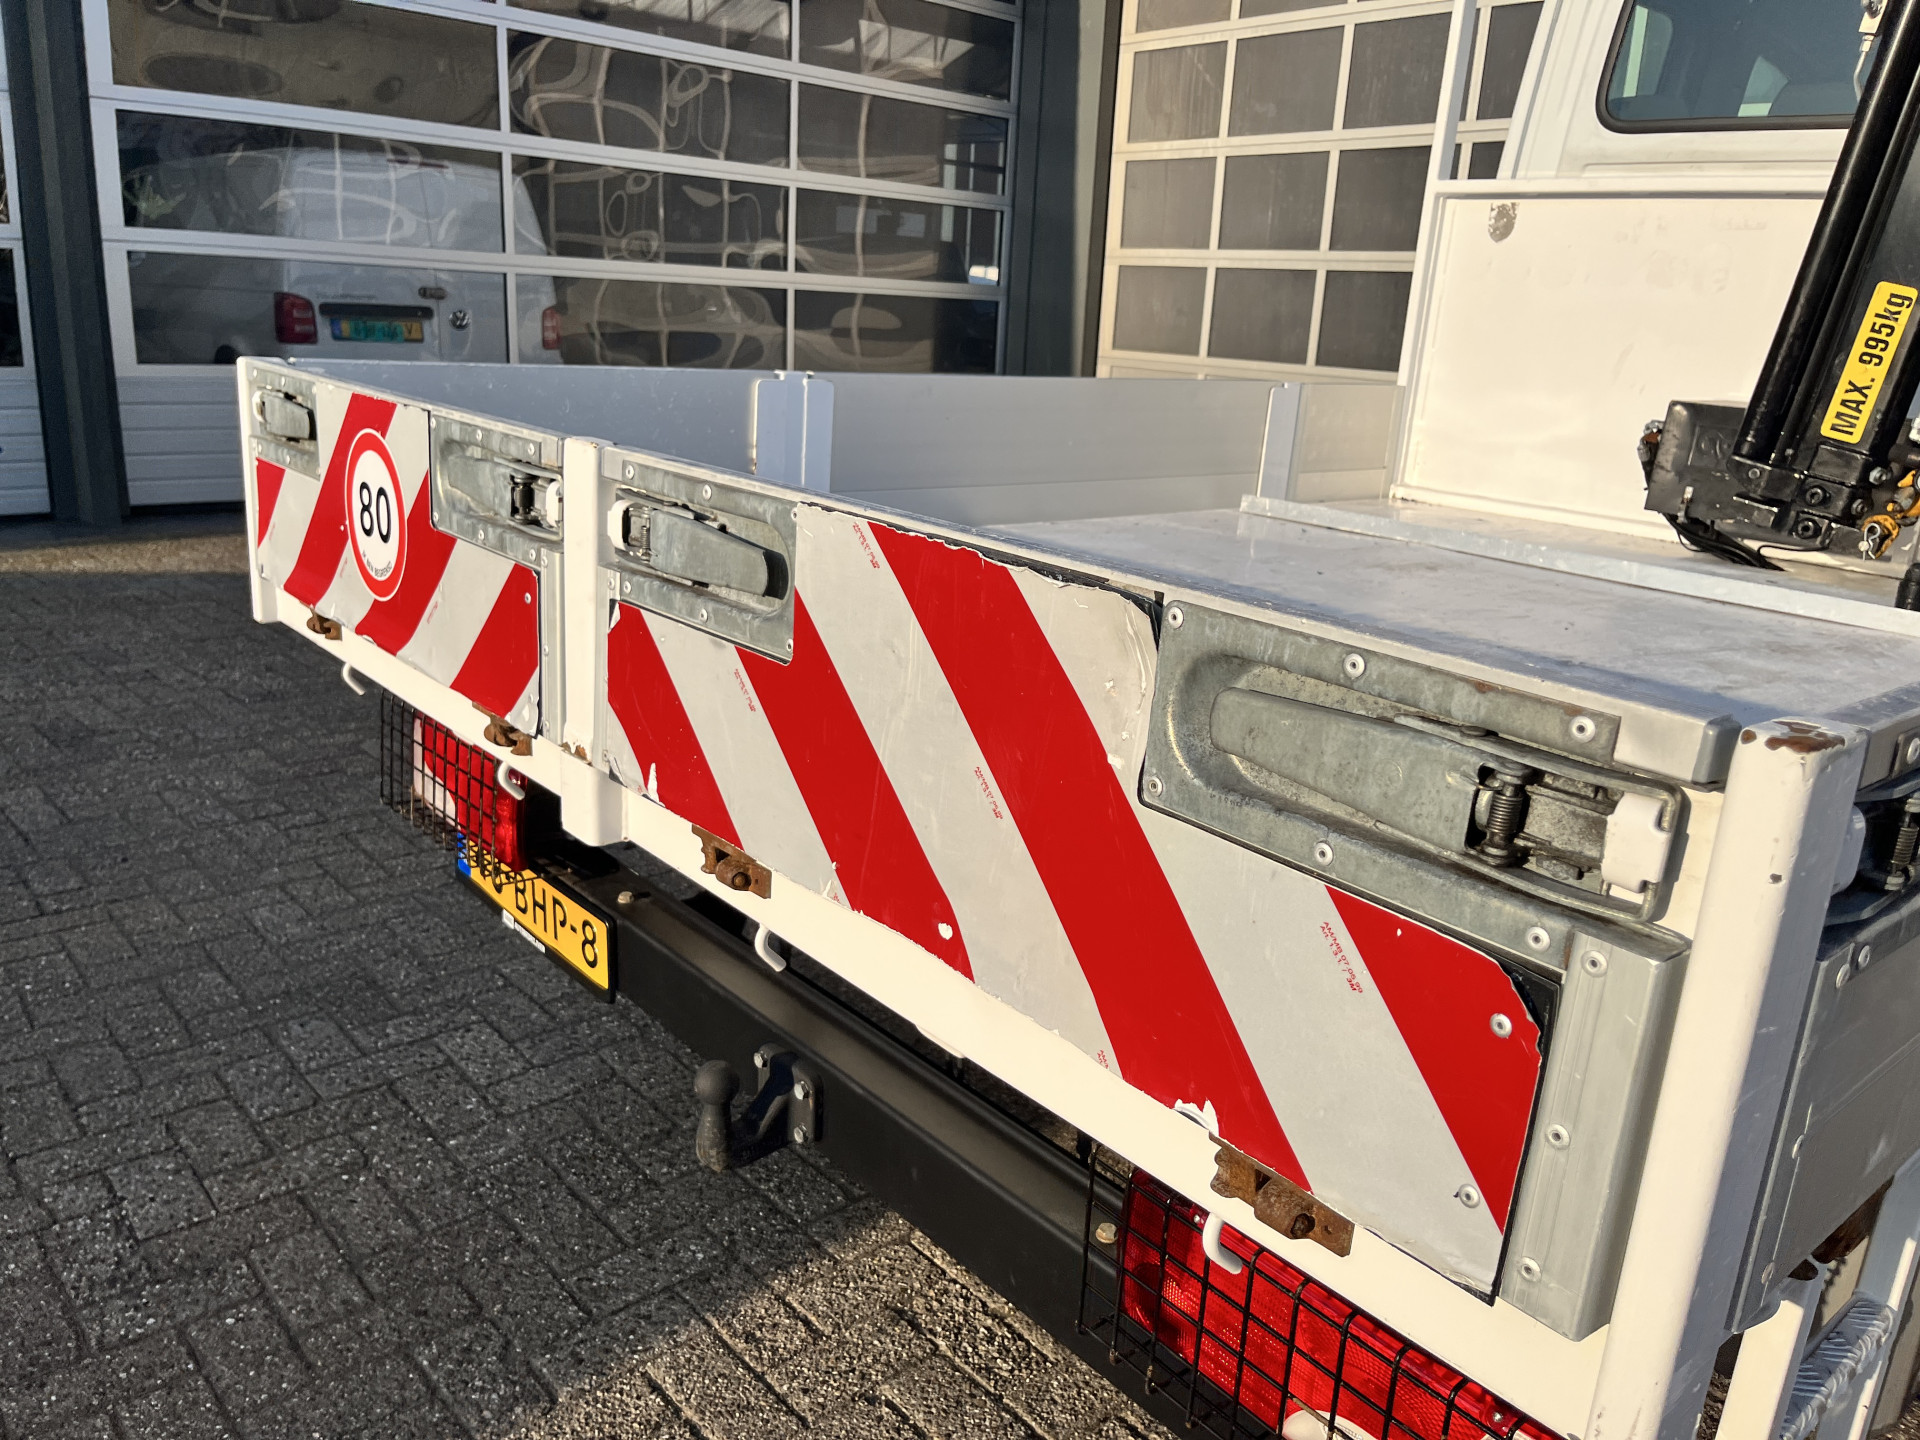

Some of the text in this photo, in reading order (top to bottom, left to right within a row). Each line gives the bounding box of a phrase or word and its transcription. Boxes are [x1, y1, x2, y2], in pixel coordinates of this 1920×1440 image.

[1829, 292, 1914, 436] MAX. 995kg
[359, 481, 391, 544] 80
